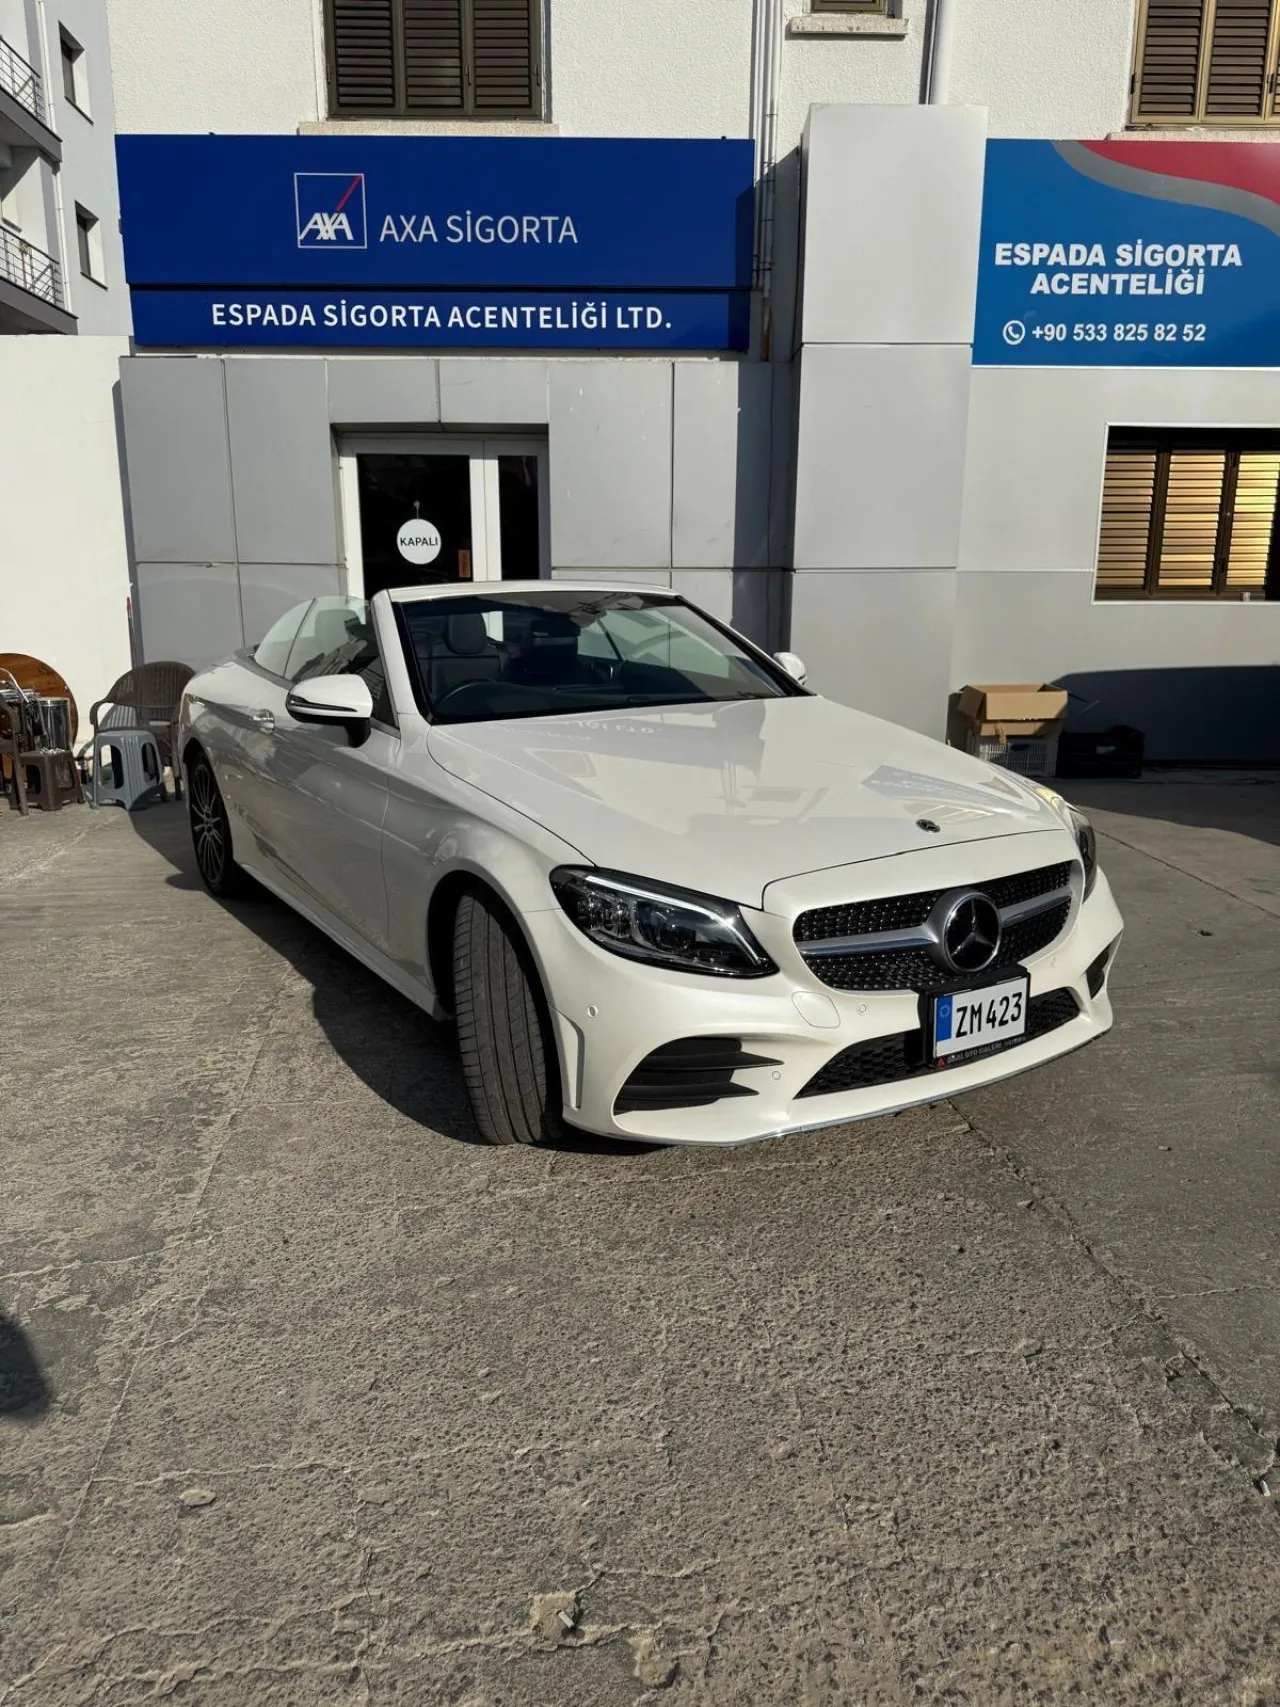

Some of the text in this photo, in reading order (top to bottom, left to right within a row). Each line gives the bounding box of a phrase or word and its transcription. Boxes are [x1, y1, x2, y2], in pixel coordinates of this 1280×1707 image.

[299, 212, 354, 240] AXA
[379, 209, 579, 244] AXA SİGORTA
[995, 239, 1243, 267] ESPADA SİGORTA
[1030, 269, 1204, 295] ACENTELİĞİ
[211, 299, 672, 329] ESPADA SİGORTA ACENTELİĞİ LTD.
[1032, 323, 1207, 342] +90 533 825 82 52
[400, 537, 438, 547] KAPALI
[956, 992, 1022, 1038] ZM 423
